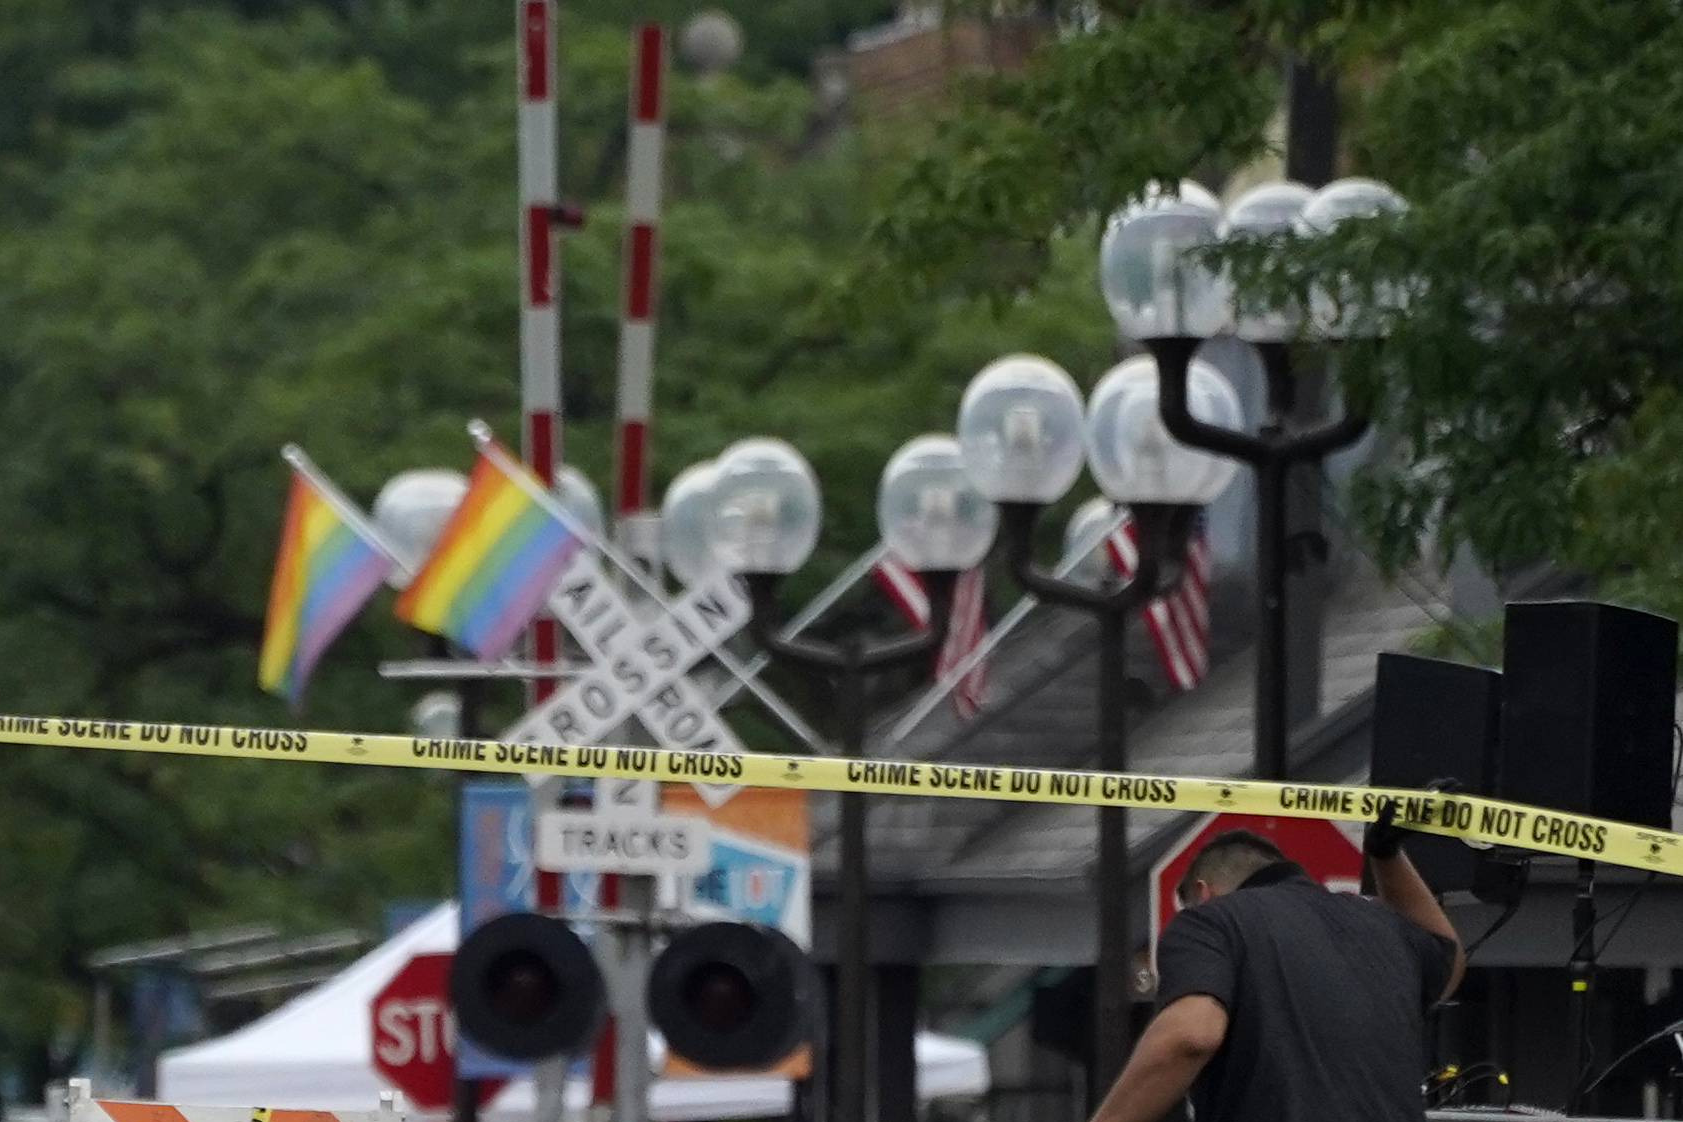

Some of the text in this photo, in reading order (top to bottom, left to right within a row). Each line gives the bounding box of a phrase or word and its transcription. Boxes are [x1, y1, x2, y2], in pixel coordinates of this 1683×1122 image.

[526, 570, 746, 746] ROSSIN
[564, 575, 717, 750] AILRO
[58, 720, 132, 741] SCENE
[140, 725, 171, 744] DO
[179, 726, 220, 747] NOT
[232, 730, 308, 753] CROSS
[412, 739, 743, 778] CRIME SCENE DO NOT CROSS
[847, 762, 1177, 803] CRIME SCENE DO NOT CROSS
[560, 827, 691, 860] TRACKS
[1279, 786, 1354, 815] CRIME
[1441, 800, 1473, 831] DO
[1479, 806, 1526, 838] NOT
[1532, 814, 1608, 854] CROSS
[375, 999, 455, 1067] ST
